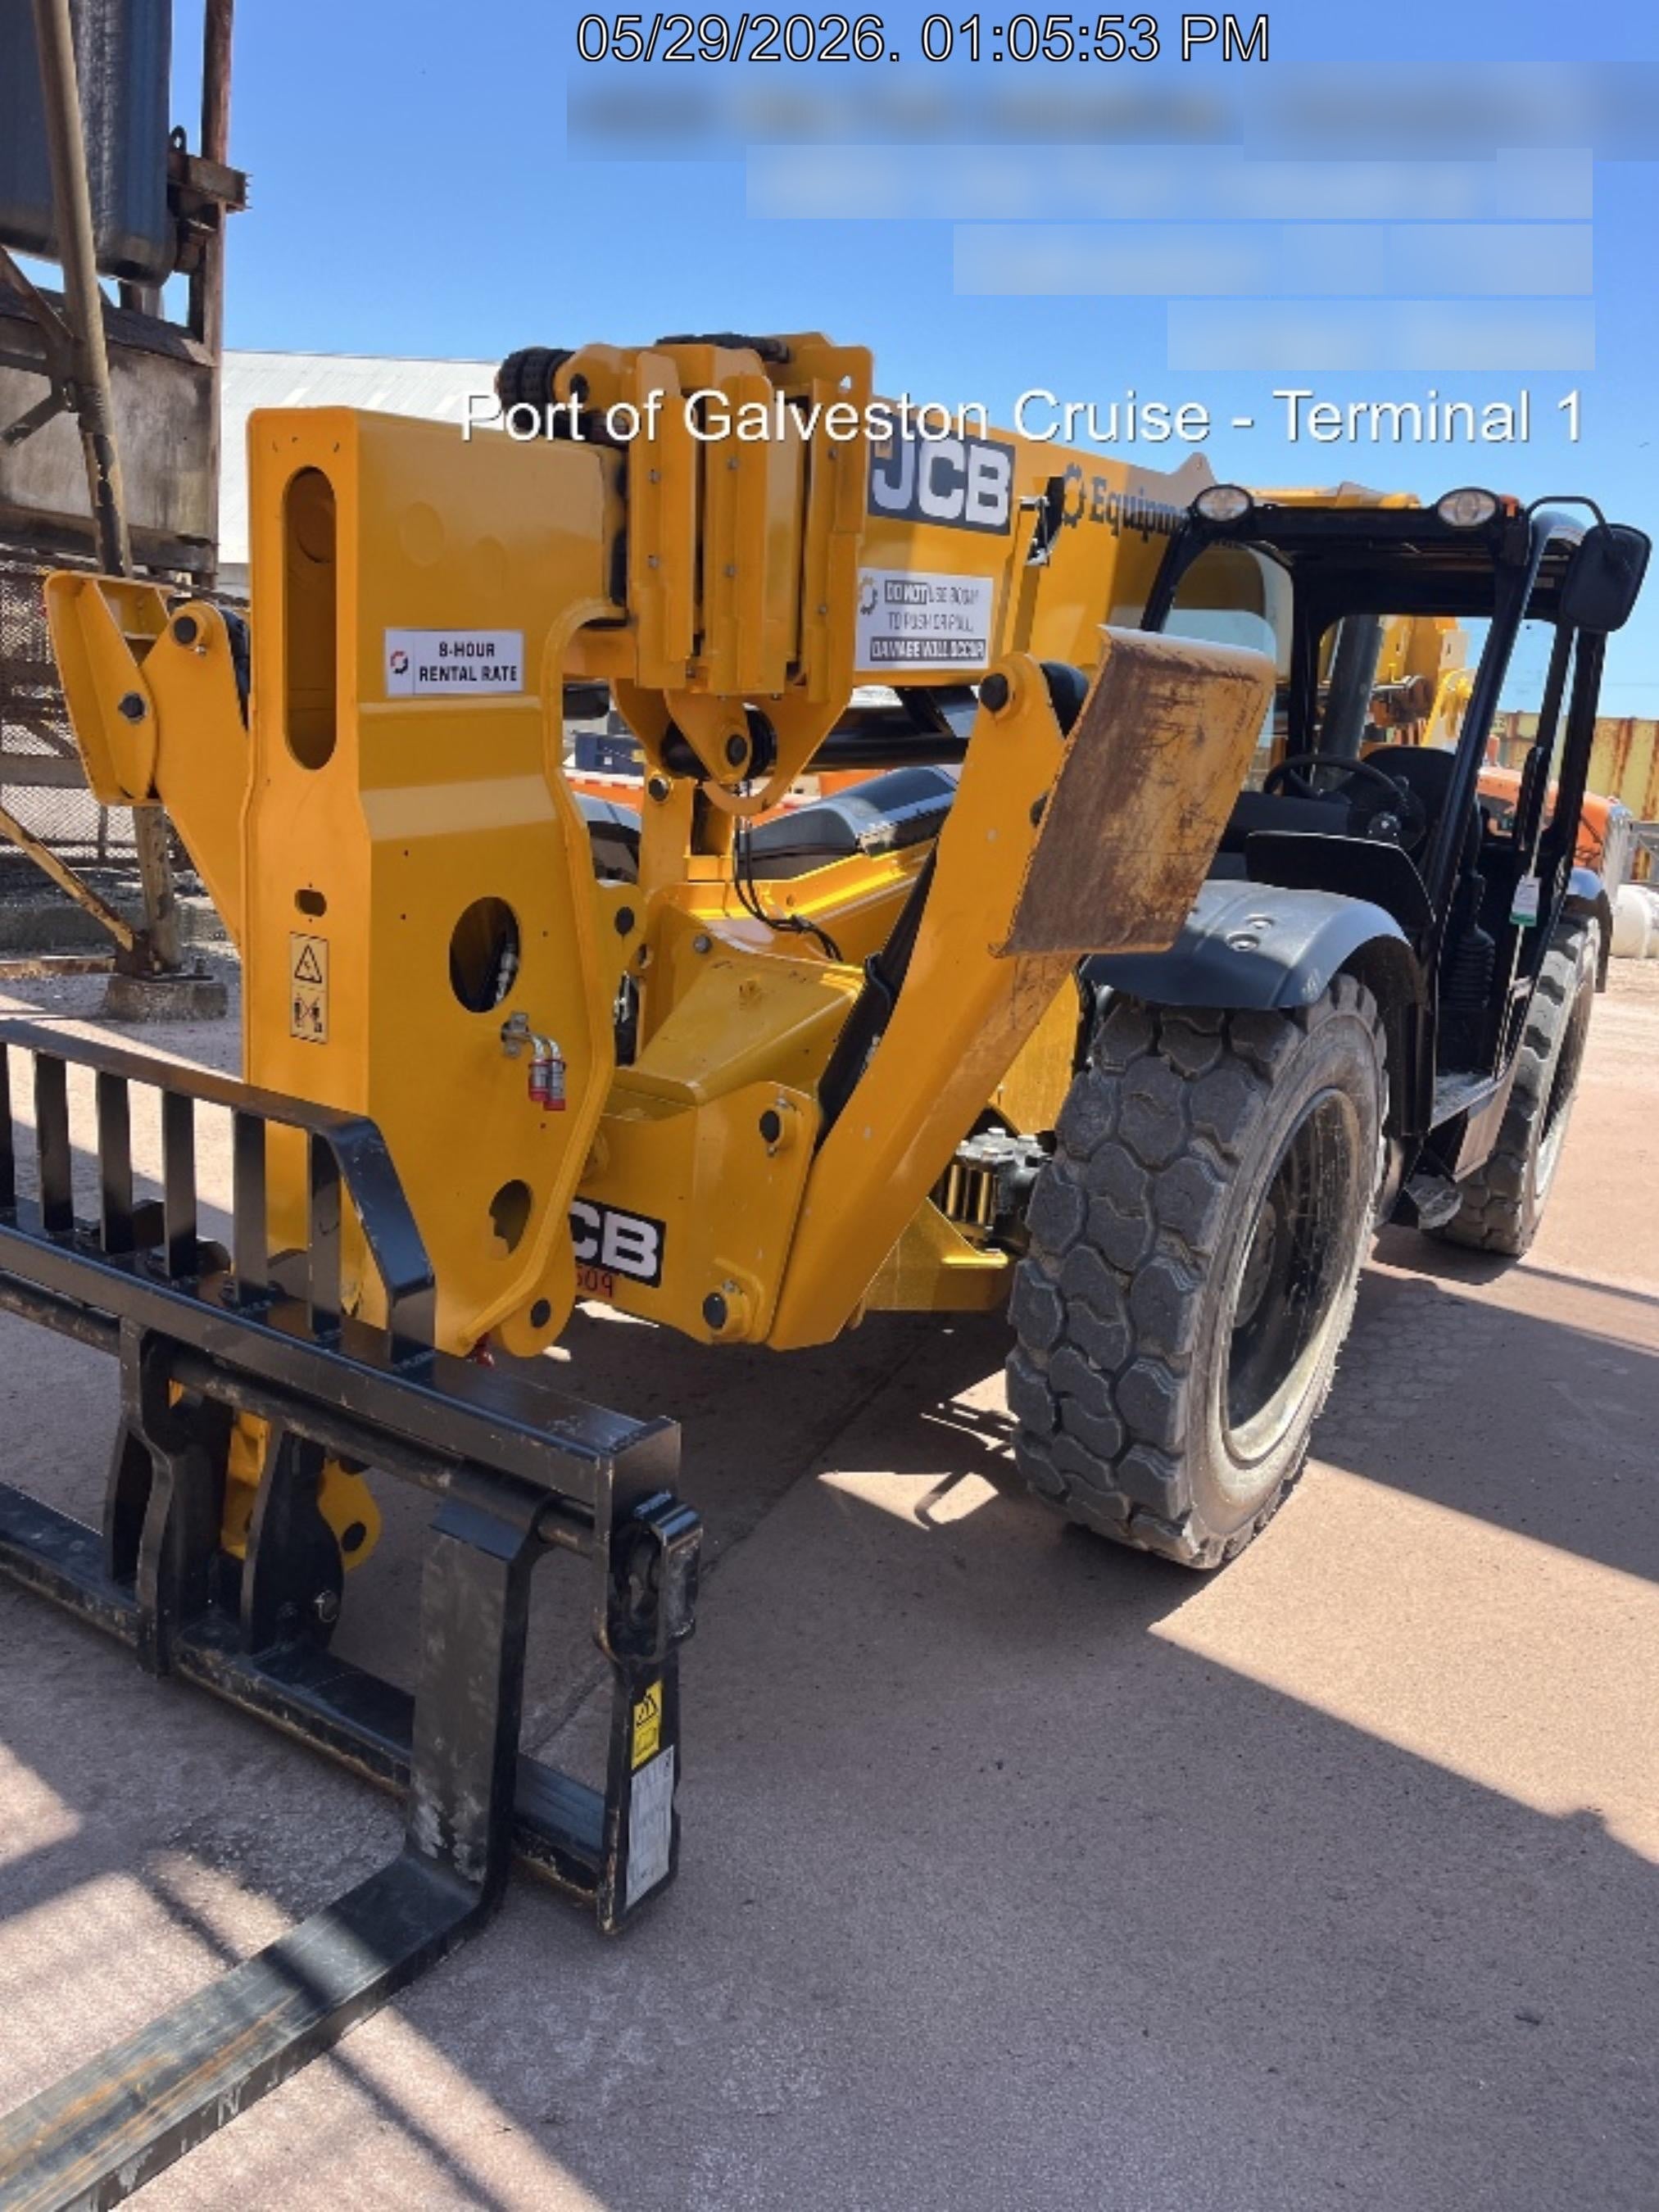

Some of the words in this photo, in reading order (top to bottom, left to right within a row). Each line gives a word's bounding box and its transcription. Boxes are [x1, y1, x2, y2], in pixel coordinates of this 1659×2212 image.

[873, 430, 1011, 528] JCB
[904, 583, 927, 603] NOT
[438, 641, 496, 658] 8-HOUR
[419, 665, 478, 682] RENTAL
[481, 665, 518, 682] RATE
[569, 1200, 658, 1278] CB
